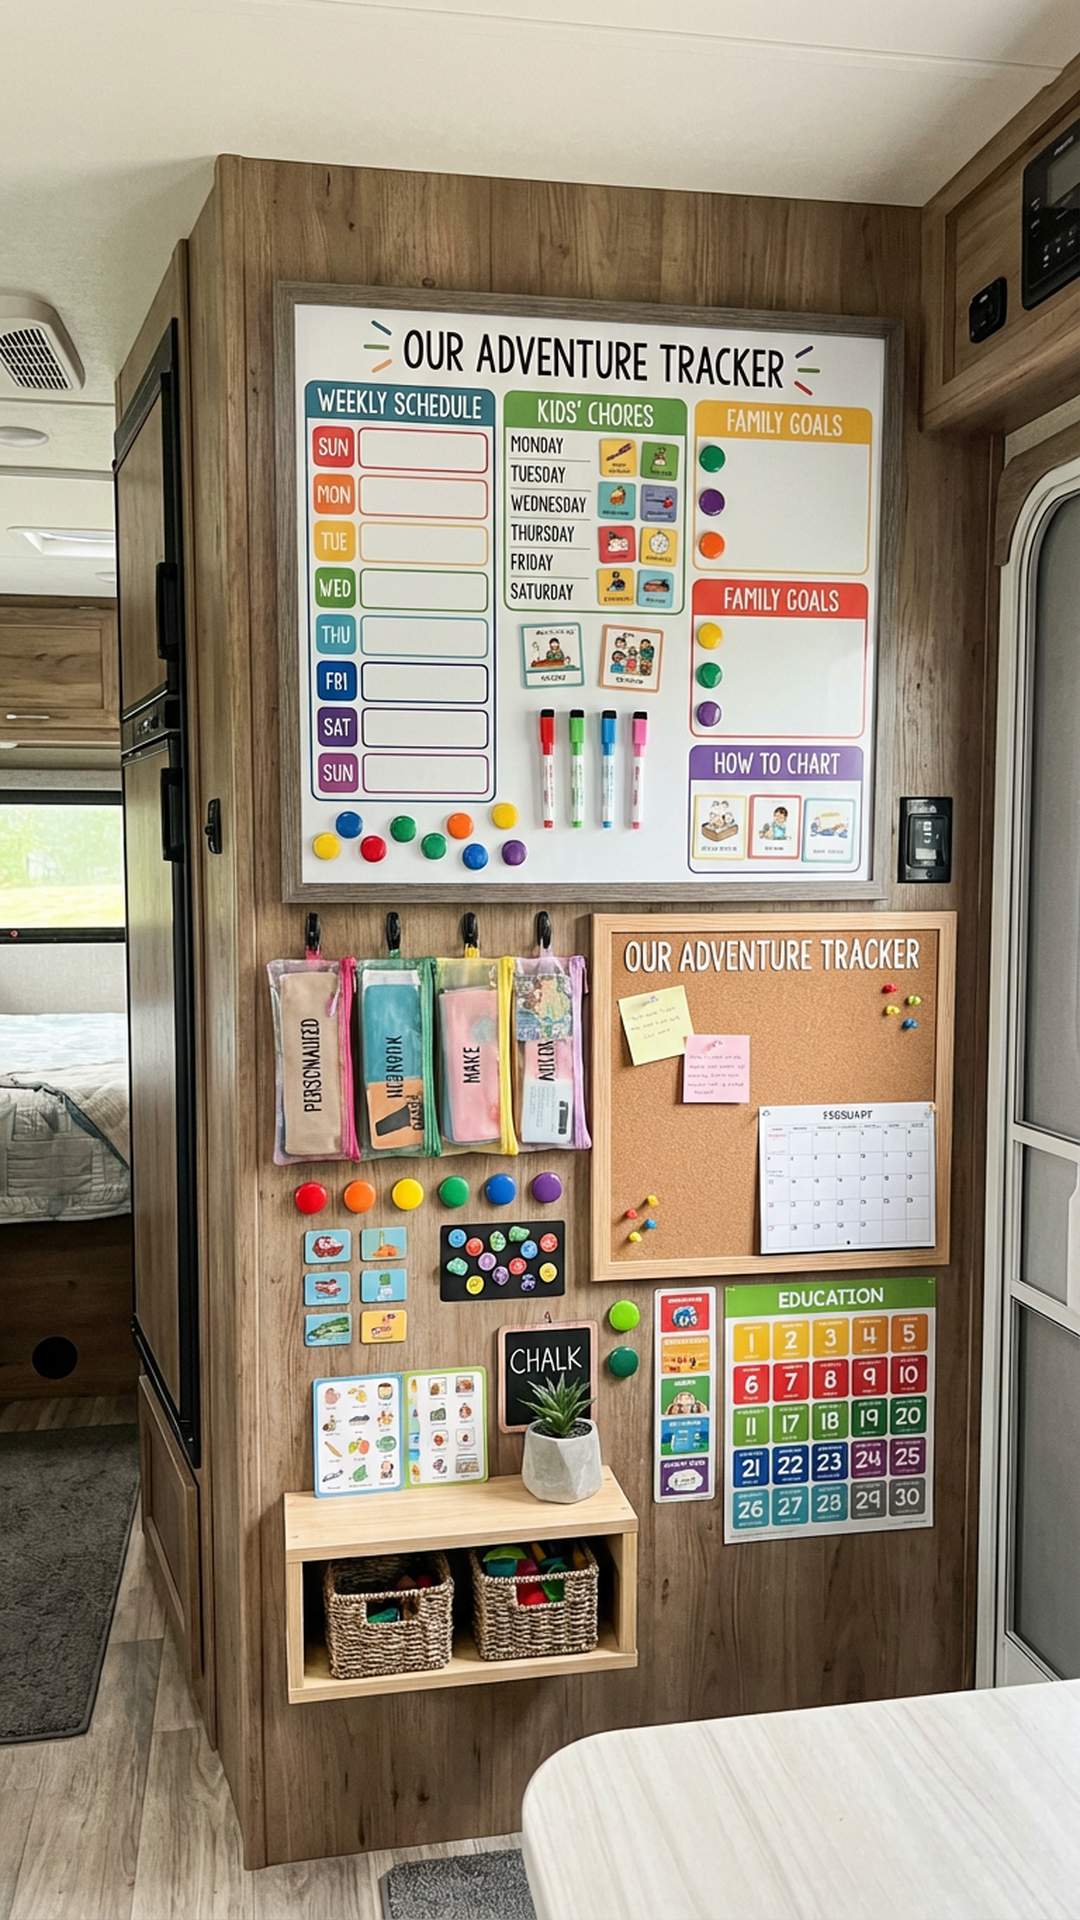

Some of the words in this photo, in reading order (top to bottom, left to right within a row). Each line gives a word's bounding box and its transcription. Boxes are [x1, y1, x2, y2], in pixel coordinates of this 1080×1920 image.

[403, 329, 464, 372] OUR
[476, 333, 648, 382] ADVENTURE
[659, 343, 784, 389] TRACKER
[317, 387, 388, 415] WEEKLY
[394, 391, 482, 420] SCHEDULE
[537, 398, 582, 424] KIDS'
[587, 401, 654, 428] CHORES
[726, 408, 784, 434] FAMILY
[789, 412, 843, 437] GOALS
[318, 436, 349, 457] SUN
[510, 434, 564, 455] MONDAY
[510, 464, 566, 484] TUESDAY
[317, 484, 352, 505] MON
[510, 494, 587, 514] WEDNESDAY
[320, 530, 348, 552] TUE
[510, 523, 575, 543] THURSDAY
[510, 553, 554, 572] FRIDAY
[319, 578, 351, 598] WED
[510, 582, 574, 601] SATURDAY
[724, 586, 781, 611] FAMILY
[786, 588, 839, 613] GOALS
[321, 625, 351, 645] THU
[323, 717, 352, 737] SAT
[323, 763, 354, 782] SUN
[714, 751, 754, 775] HOW
[759, 752, 781, 775] TO
[787, 752, 841, 775] CHART
[625, 940, 672, 973] OUR
[680, 939, 813, 972] ADVENTURE
[820, 938, 920, 970] TRACKER
[462, 1046, 481, 1084] MAKE
[778, 1287, 884, 1309] EDUCATION
[748, 1331, 755, 1354] 1
[784, 1329, 798, 1350] 2
[824, 1327, 837, 1348] 3
[862, 1326, 878, 1345] 4
[903, 1323, 916, 1344] 5
[509, 1345, 583, 1375] CHALK
[744, 1374, 759, 1395] 6
[784, 1372, 798, 1392] 7
[824, 1369, 837, 1389] 8
[863, 1367, 877, 1386] 9
[899, 1365, 919, 1384] 10
[745, 1416, 757, 1437] 11
[782, 1413, 800, 1434] 17
[821, 1411, 840, 1431] 18
[860, 1408, 879, 1428] 19
[895, 1406, 921, 1426] 20
[741, 1458, 760, 1478] 21
[777, 1455, 803, 1475] 22
[816, 1452, 842, 1472] 23
[895, 1446, 920, 1467] 25
[738, 1499, 764, 1519] 26
[777, 1495, 803, 1516] 27
[855, 1489, 881, 1510] 29
[895, 1487, 920, 1507] 30
